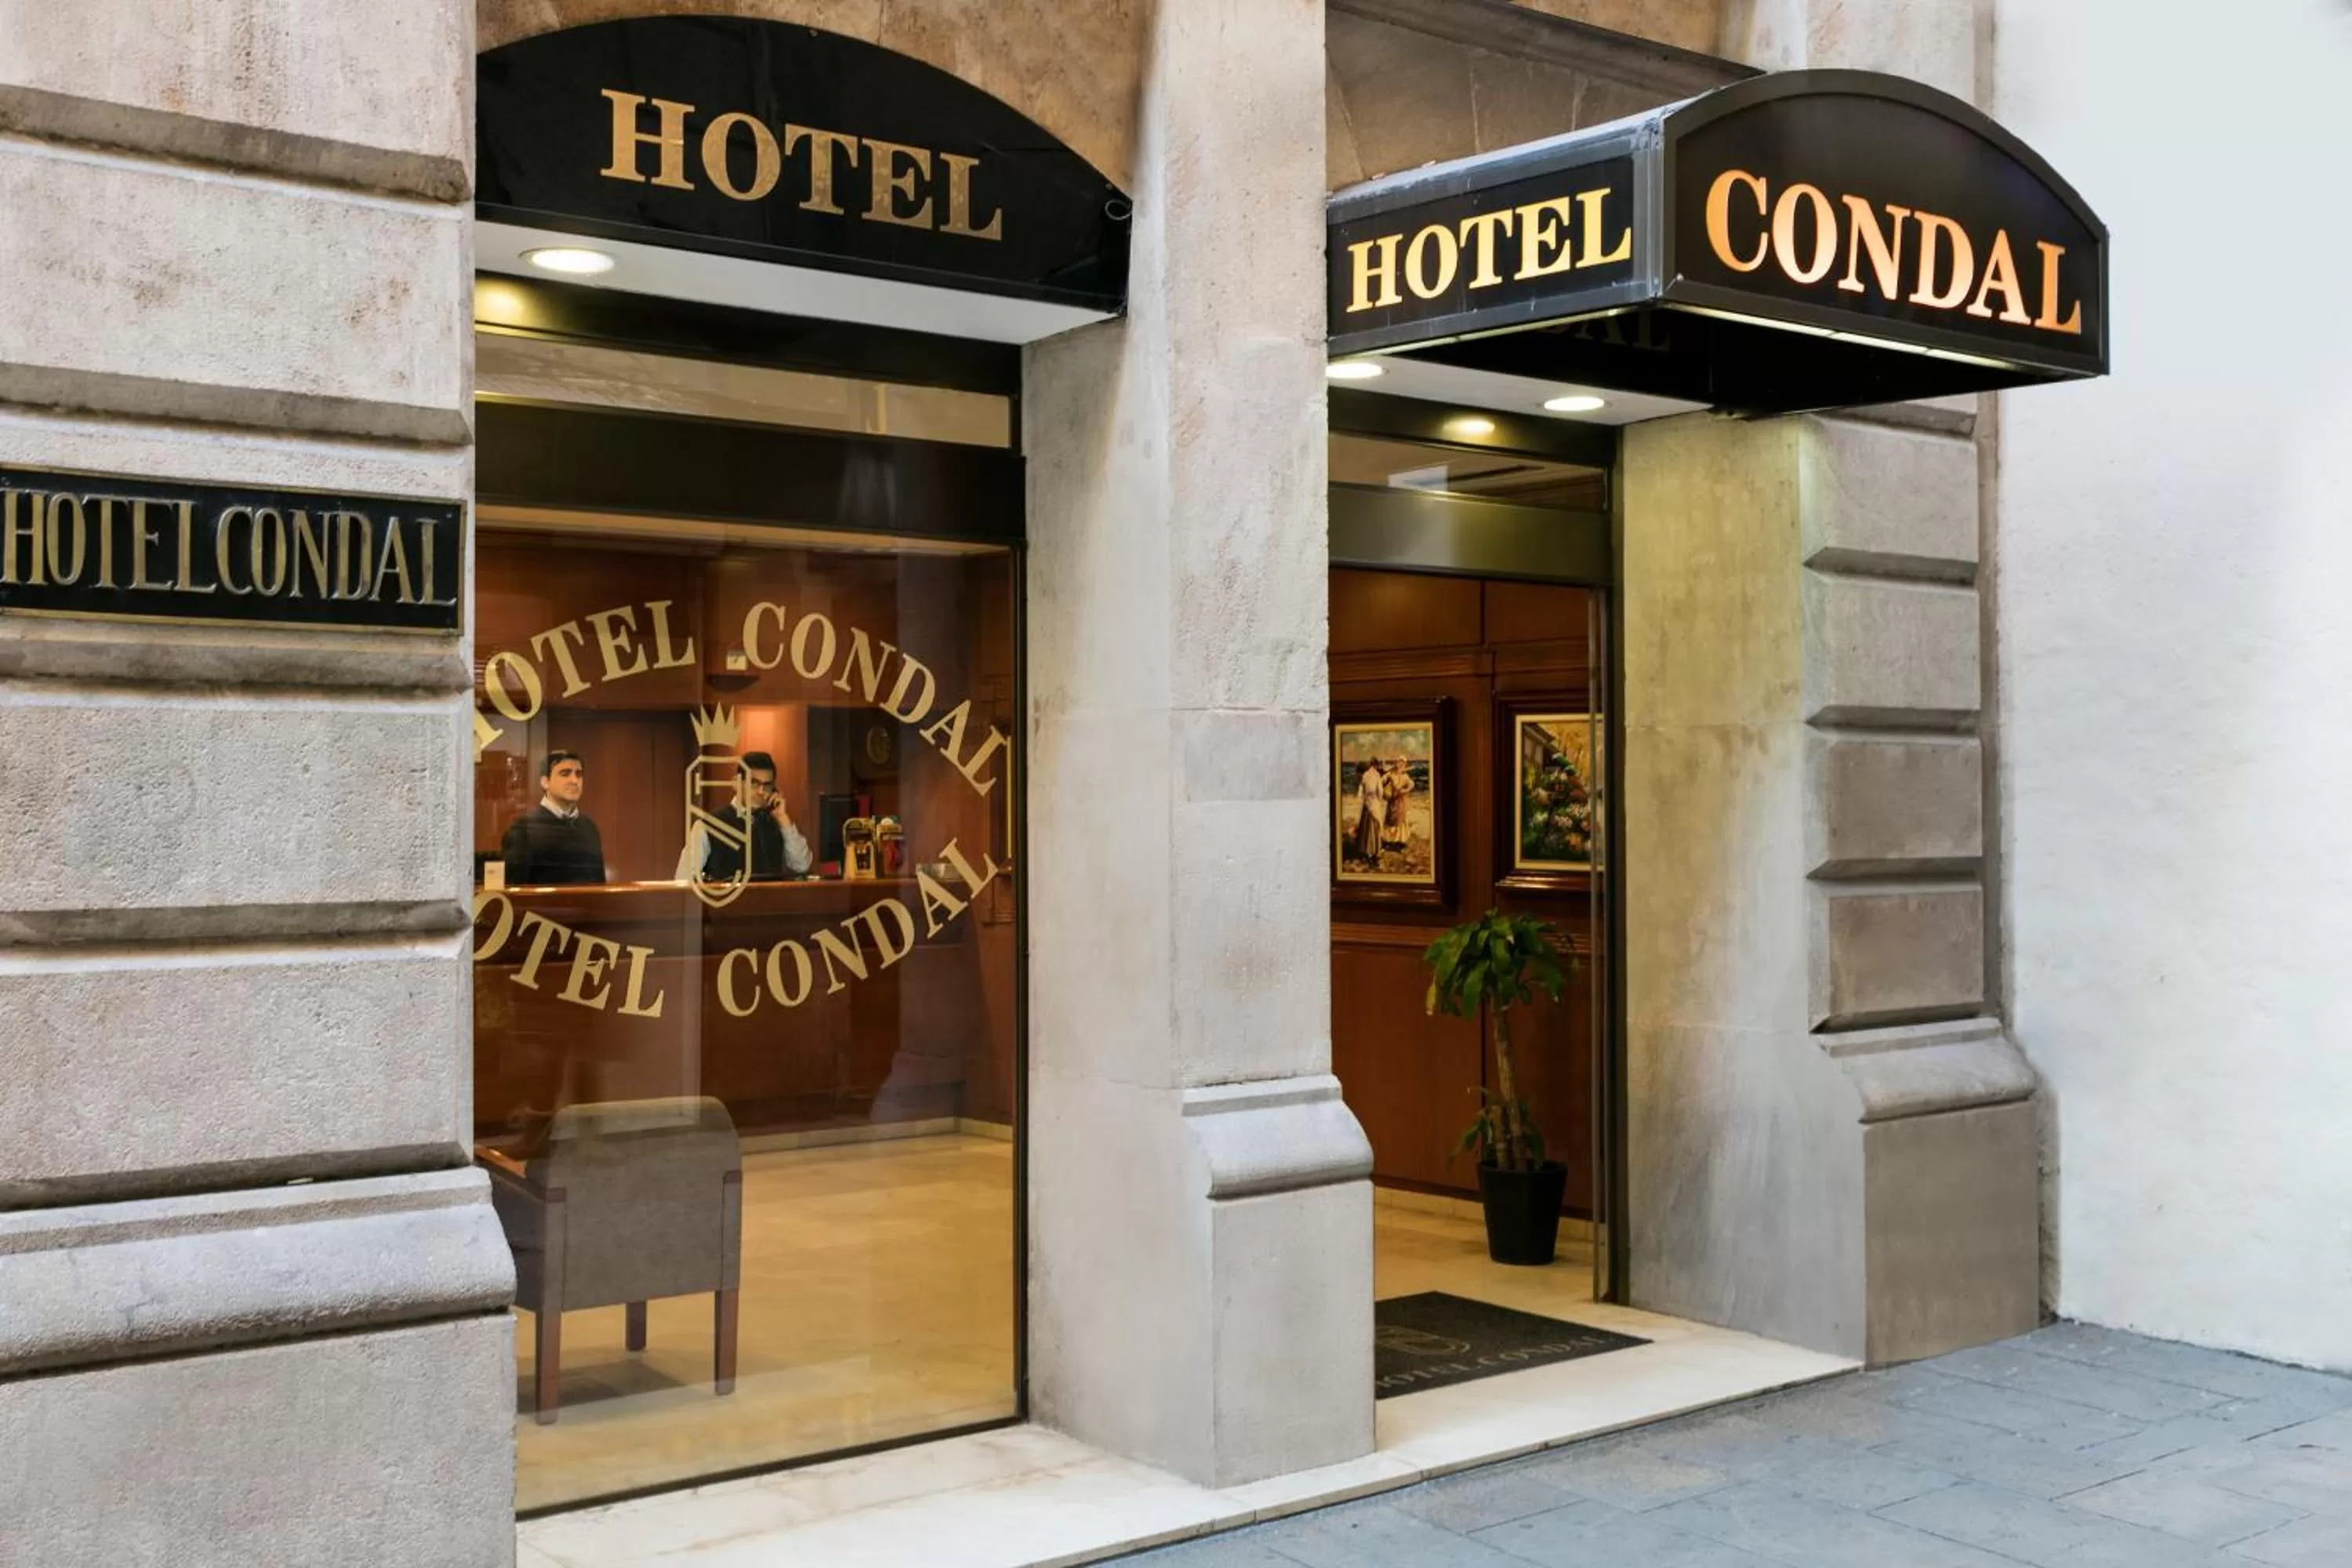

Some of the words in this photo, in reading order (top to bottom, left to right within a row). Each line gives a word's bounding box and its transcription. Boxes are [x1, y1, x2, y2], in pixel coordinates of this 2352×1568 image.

[599, 88, 1003, 241] HOTEL
[1346, 187, 1633, 314] HOTEL
[1704, 169, 2082, 335] CONDAL
[0, 487, 217, 593] HOTEL
[215, 506, 456, 605] CONDAL
[742, 601, 1010, 797] CONDAL
[717, 837, 999, 1017] CONDAL
